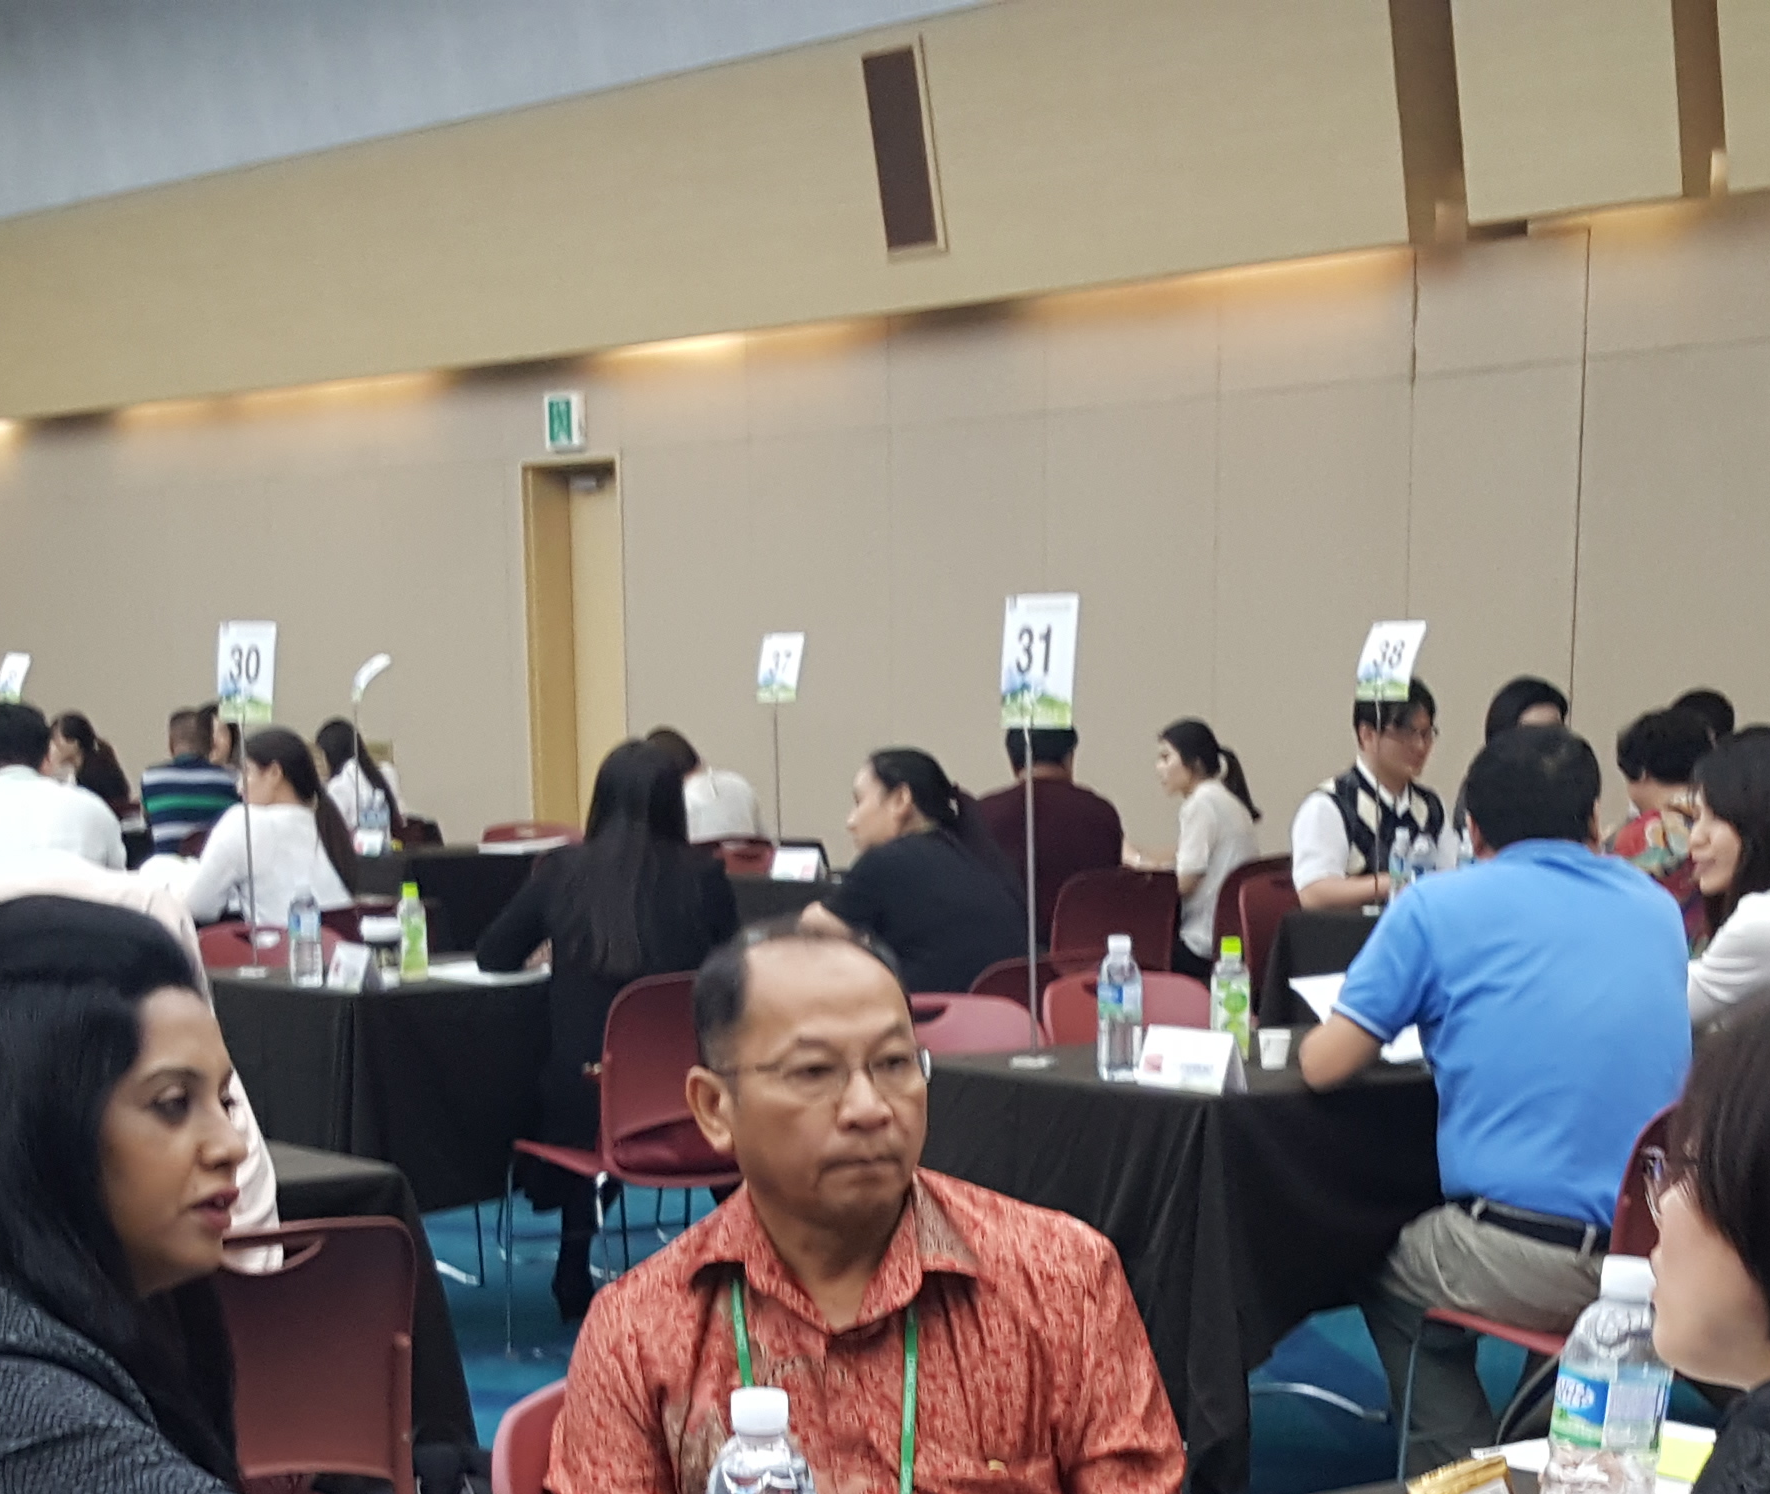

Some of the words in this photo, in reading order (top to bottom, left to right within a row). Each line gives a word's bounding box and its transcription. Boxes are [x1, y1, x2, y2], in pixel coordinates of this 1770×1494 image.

[230, 643, 260, 684] 30
[1015, 623, 1051, 676] 31
[1373, 639, 1406, 669] 38
